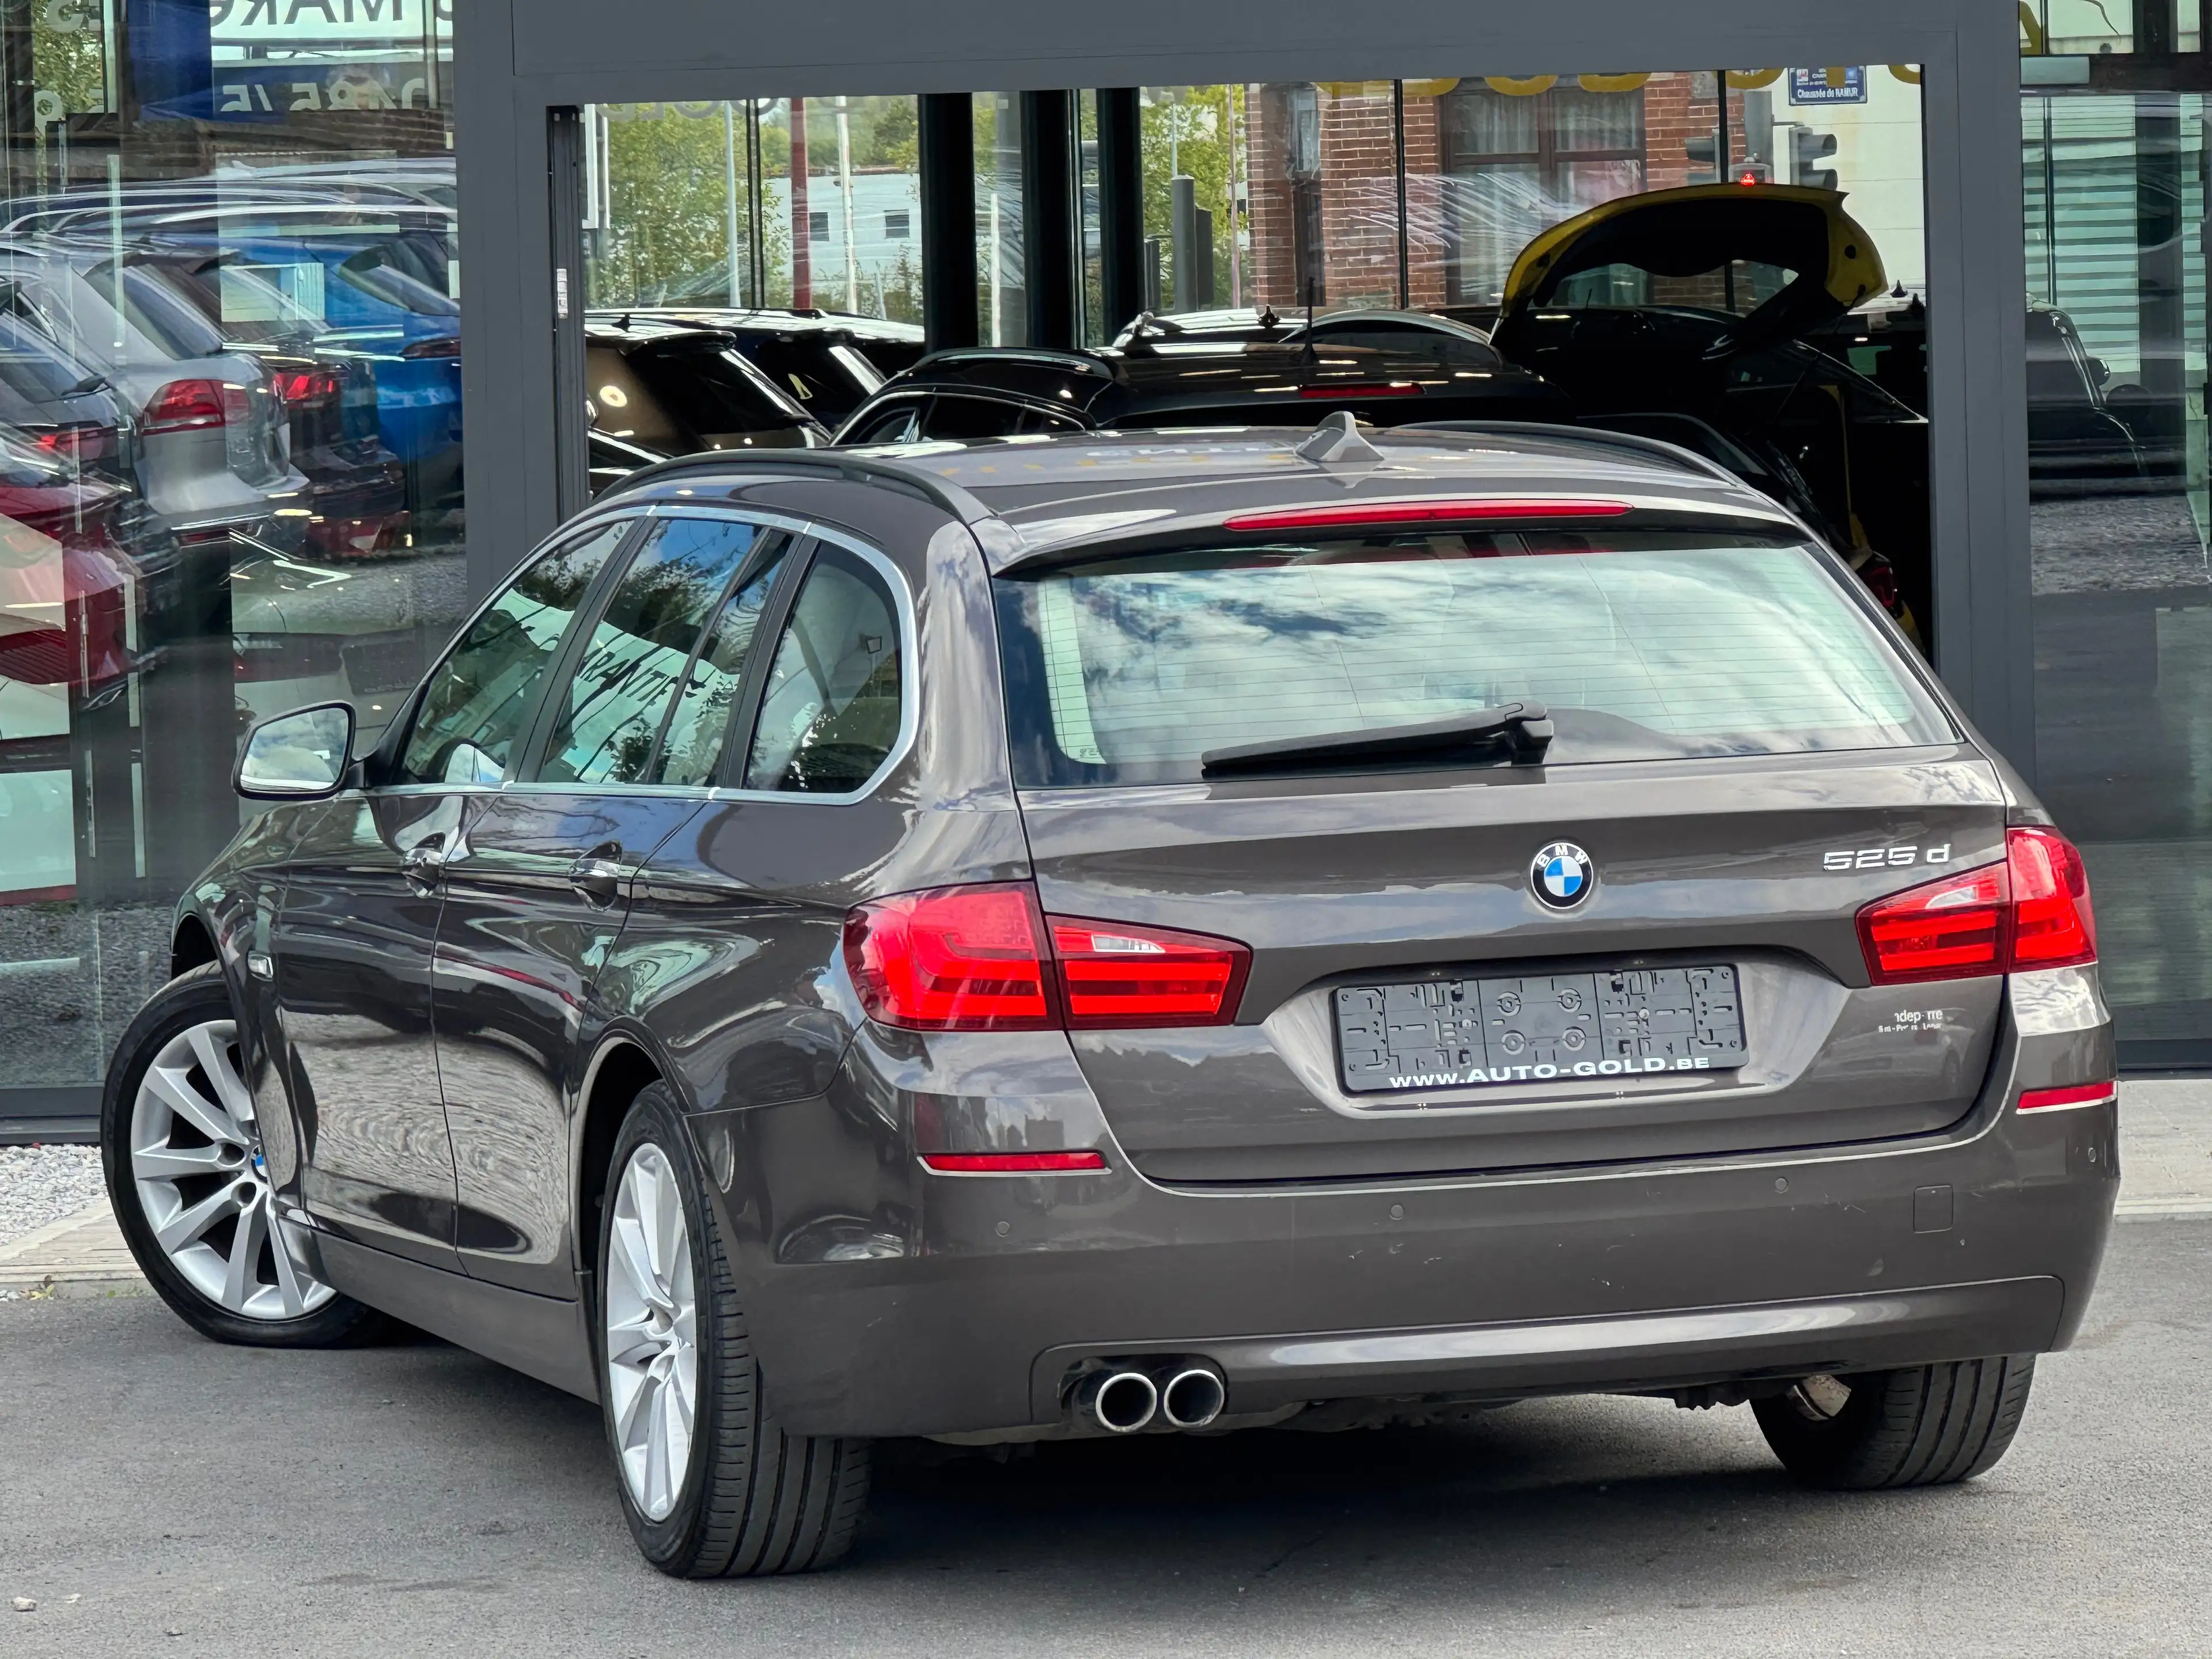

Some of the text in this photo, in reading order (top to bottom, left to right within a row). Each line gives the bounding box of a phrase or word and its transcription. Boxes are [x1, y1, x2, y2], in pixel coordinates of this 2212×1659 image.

[1536, 844, 1589, 868] BMW
[1823, 843, 1952, 871] 525 d
